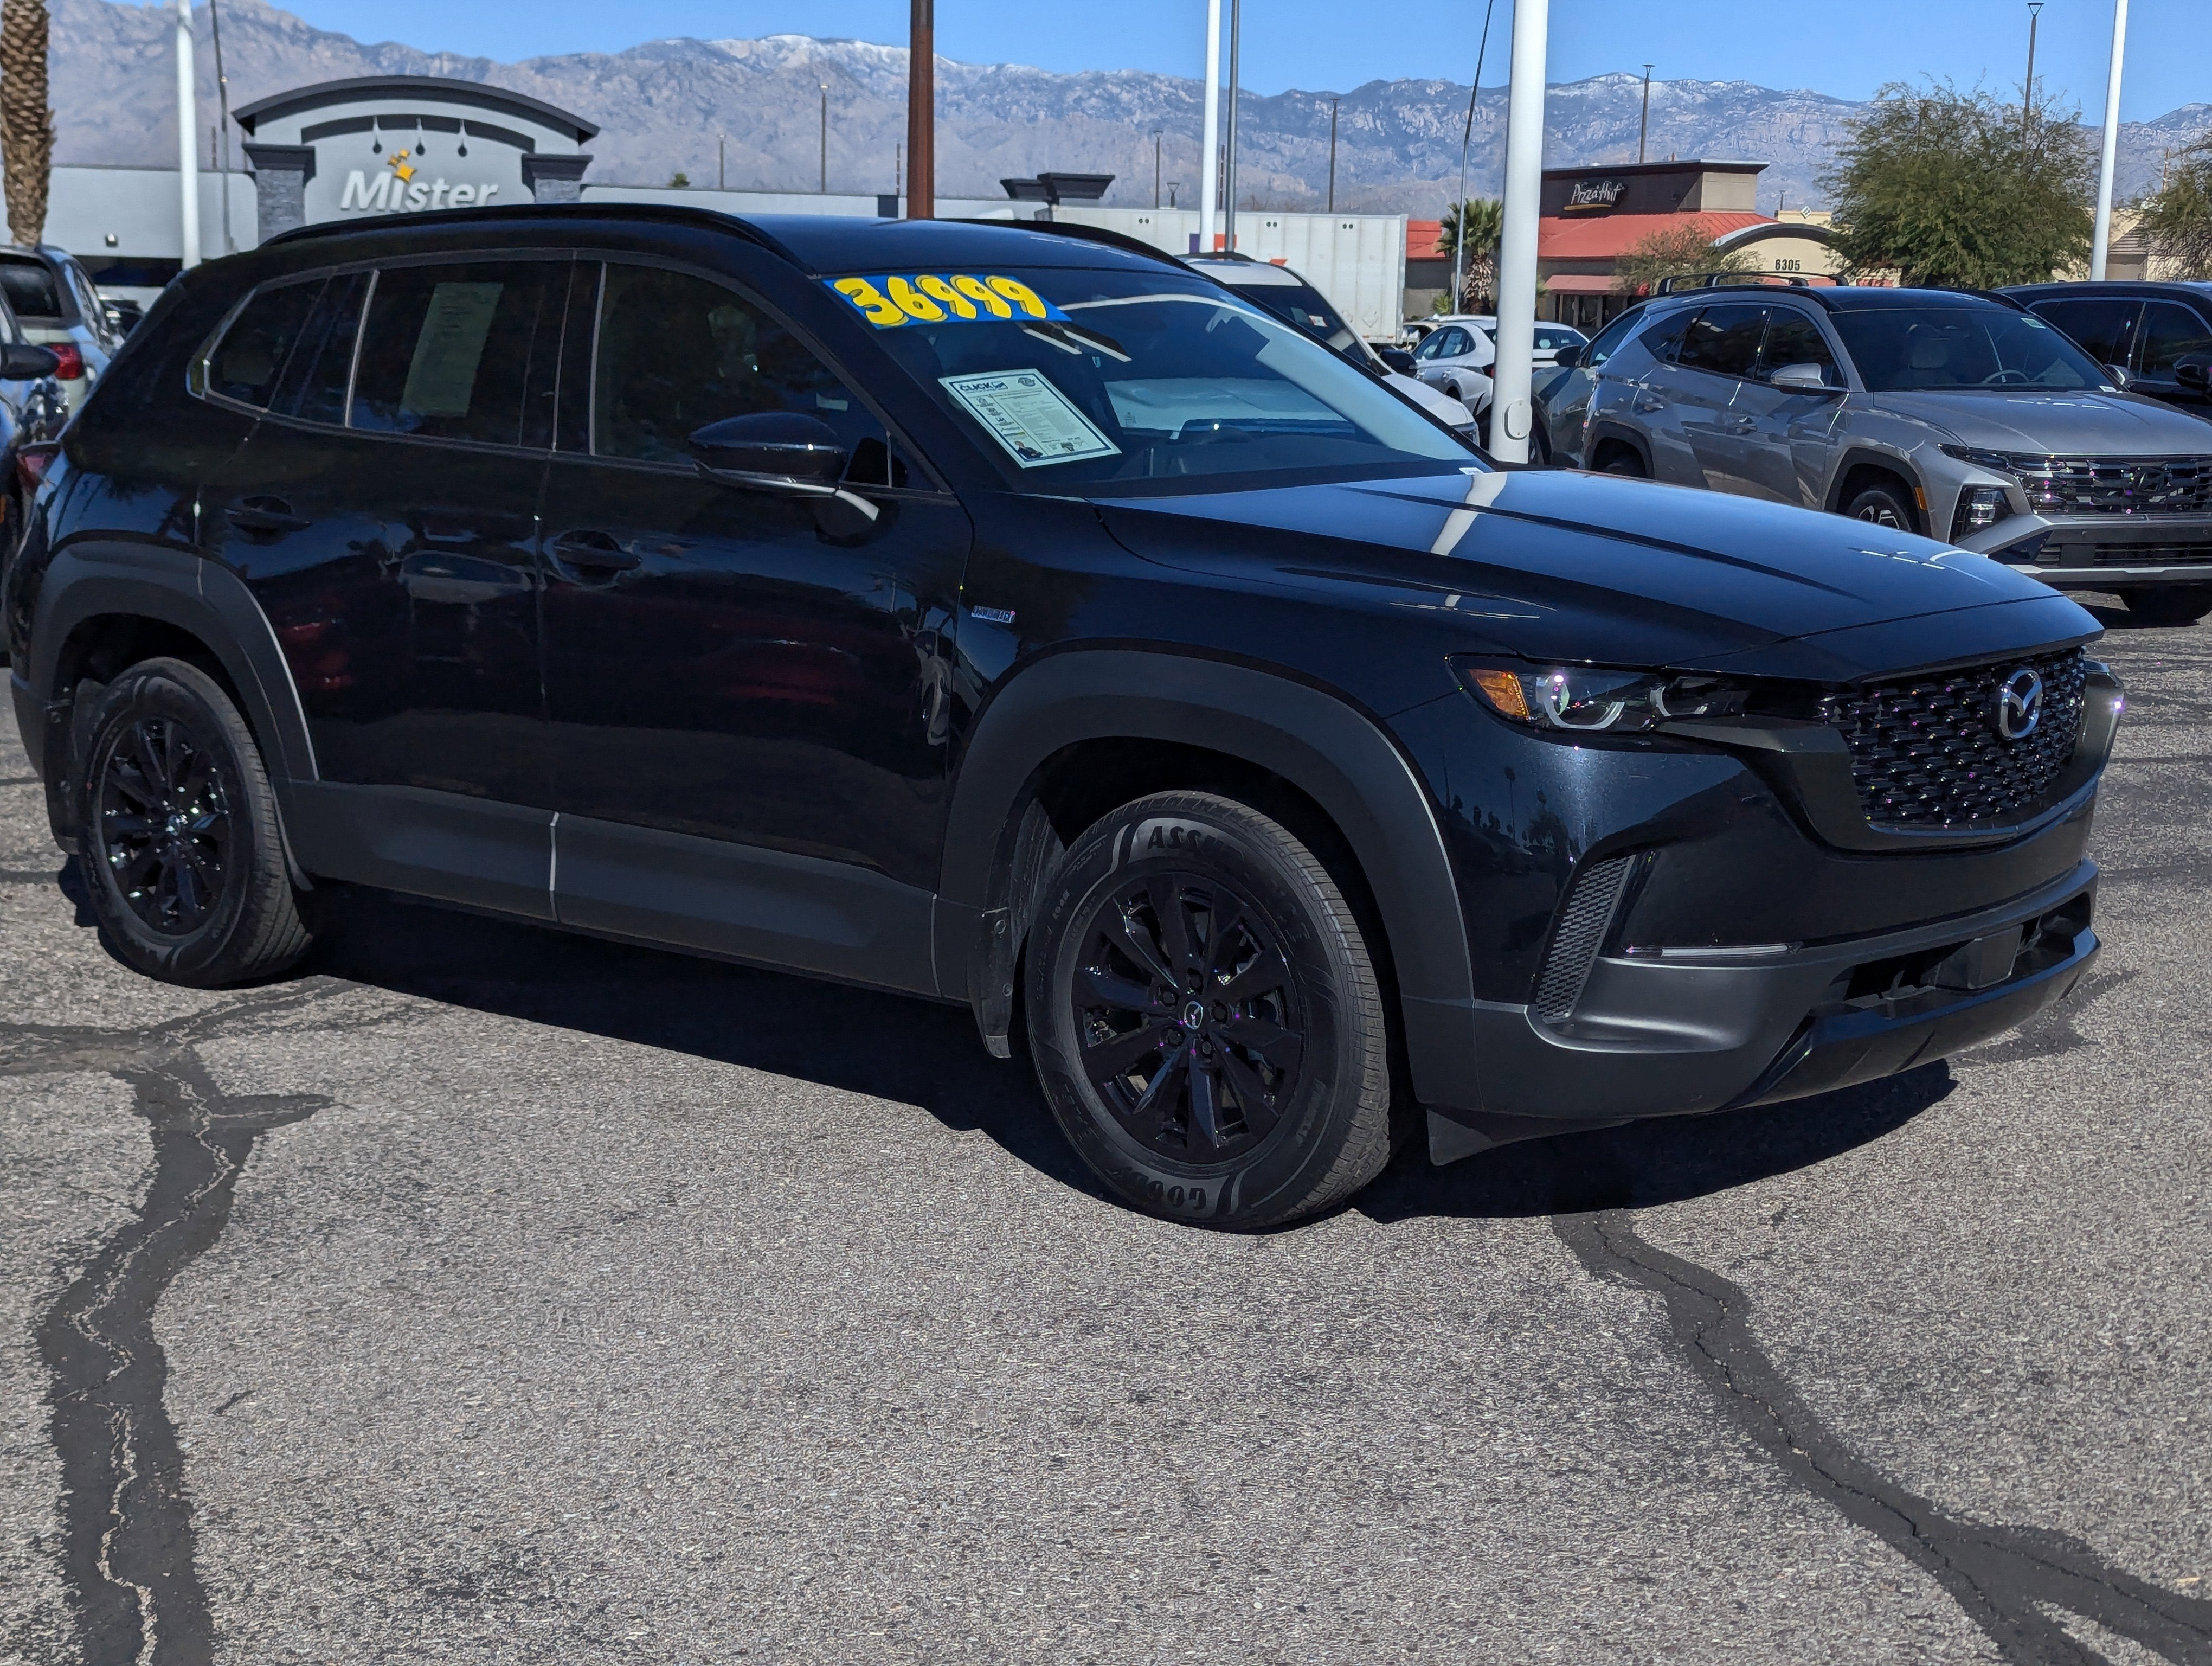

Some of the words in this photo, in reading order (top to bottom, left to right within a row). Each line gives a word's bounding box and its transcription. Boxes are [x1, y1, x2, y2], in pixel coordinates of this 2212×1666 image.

[340, 169, 499, 212] Mister
[1775, 259, 1801, 271] 6305
[834, 274, 1047, 325] 36999
